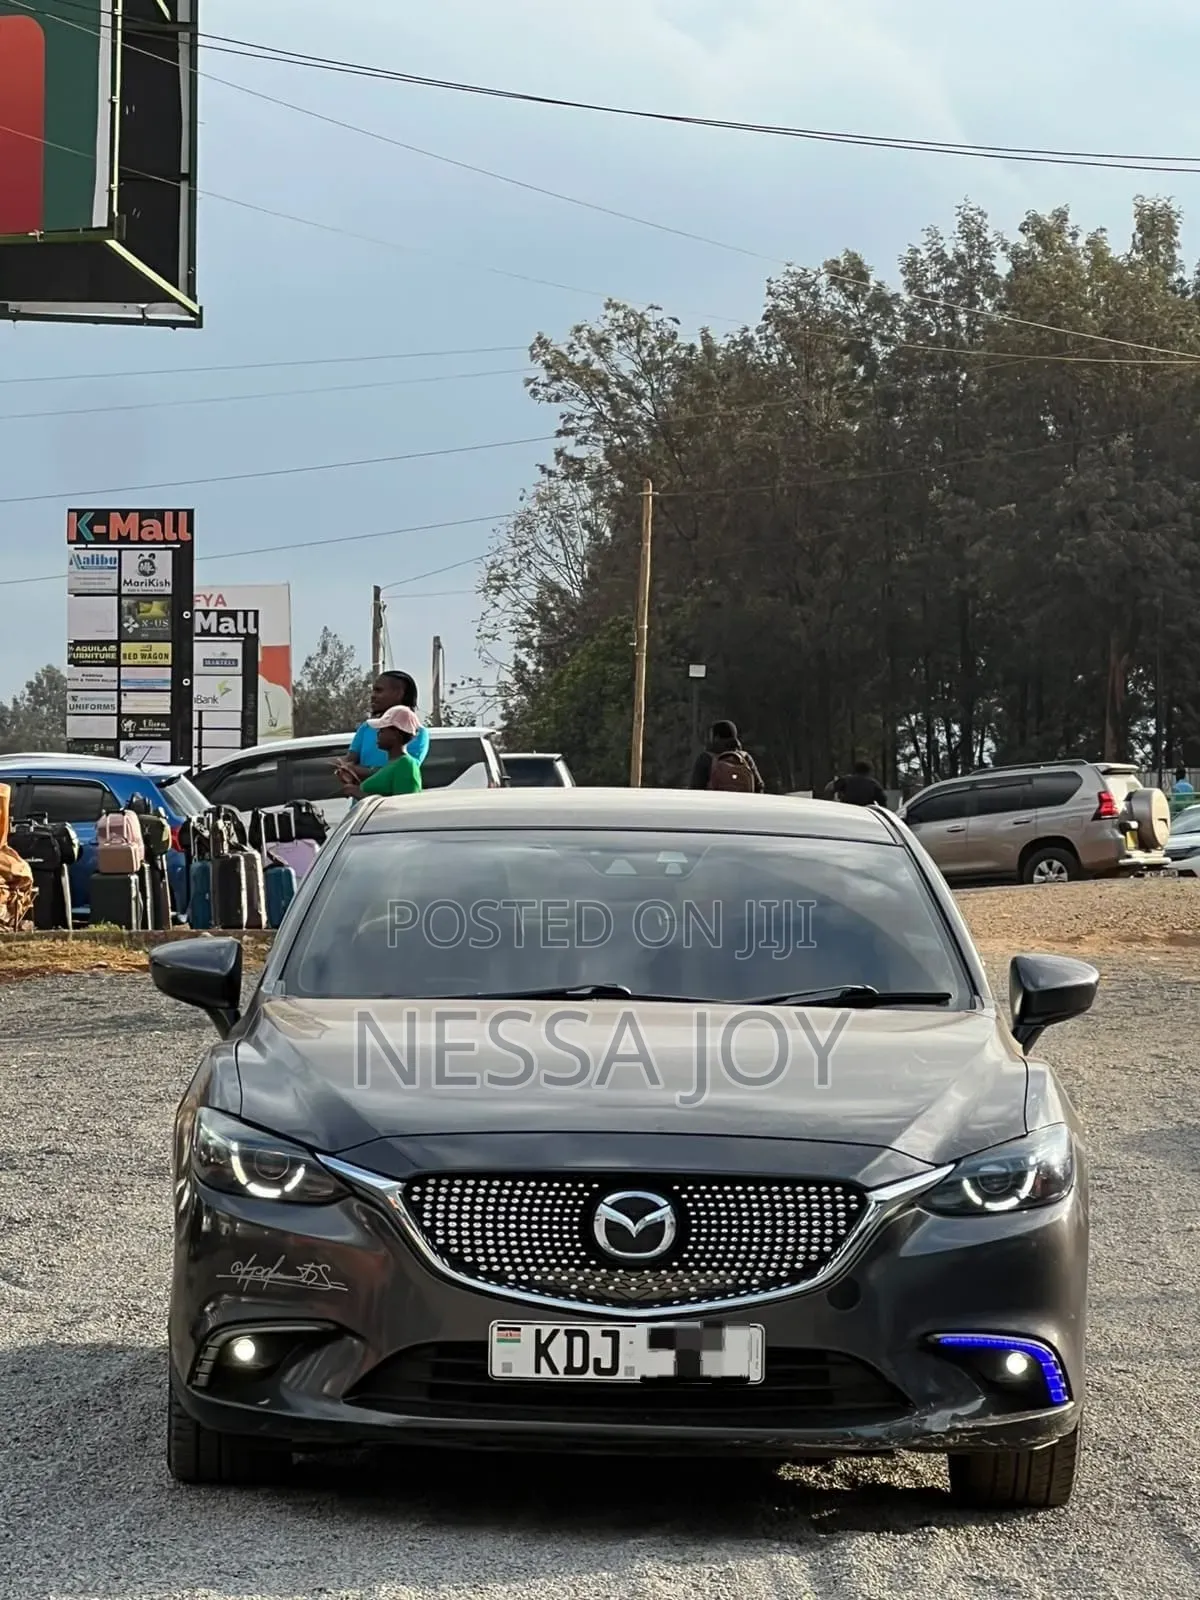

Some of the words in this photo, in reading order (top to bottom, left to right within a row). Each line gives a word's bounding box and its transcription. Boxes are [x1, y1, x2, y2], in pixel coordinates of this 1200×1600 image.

[68, 511, 192, 541] K-Mall
[122, 578, 171, 588] MariKish
[140, 652, 170, 660] WAGON
[68, 703, 116, 711] UNIFORMS
[534, 1328, 621, 1377] KDJ
